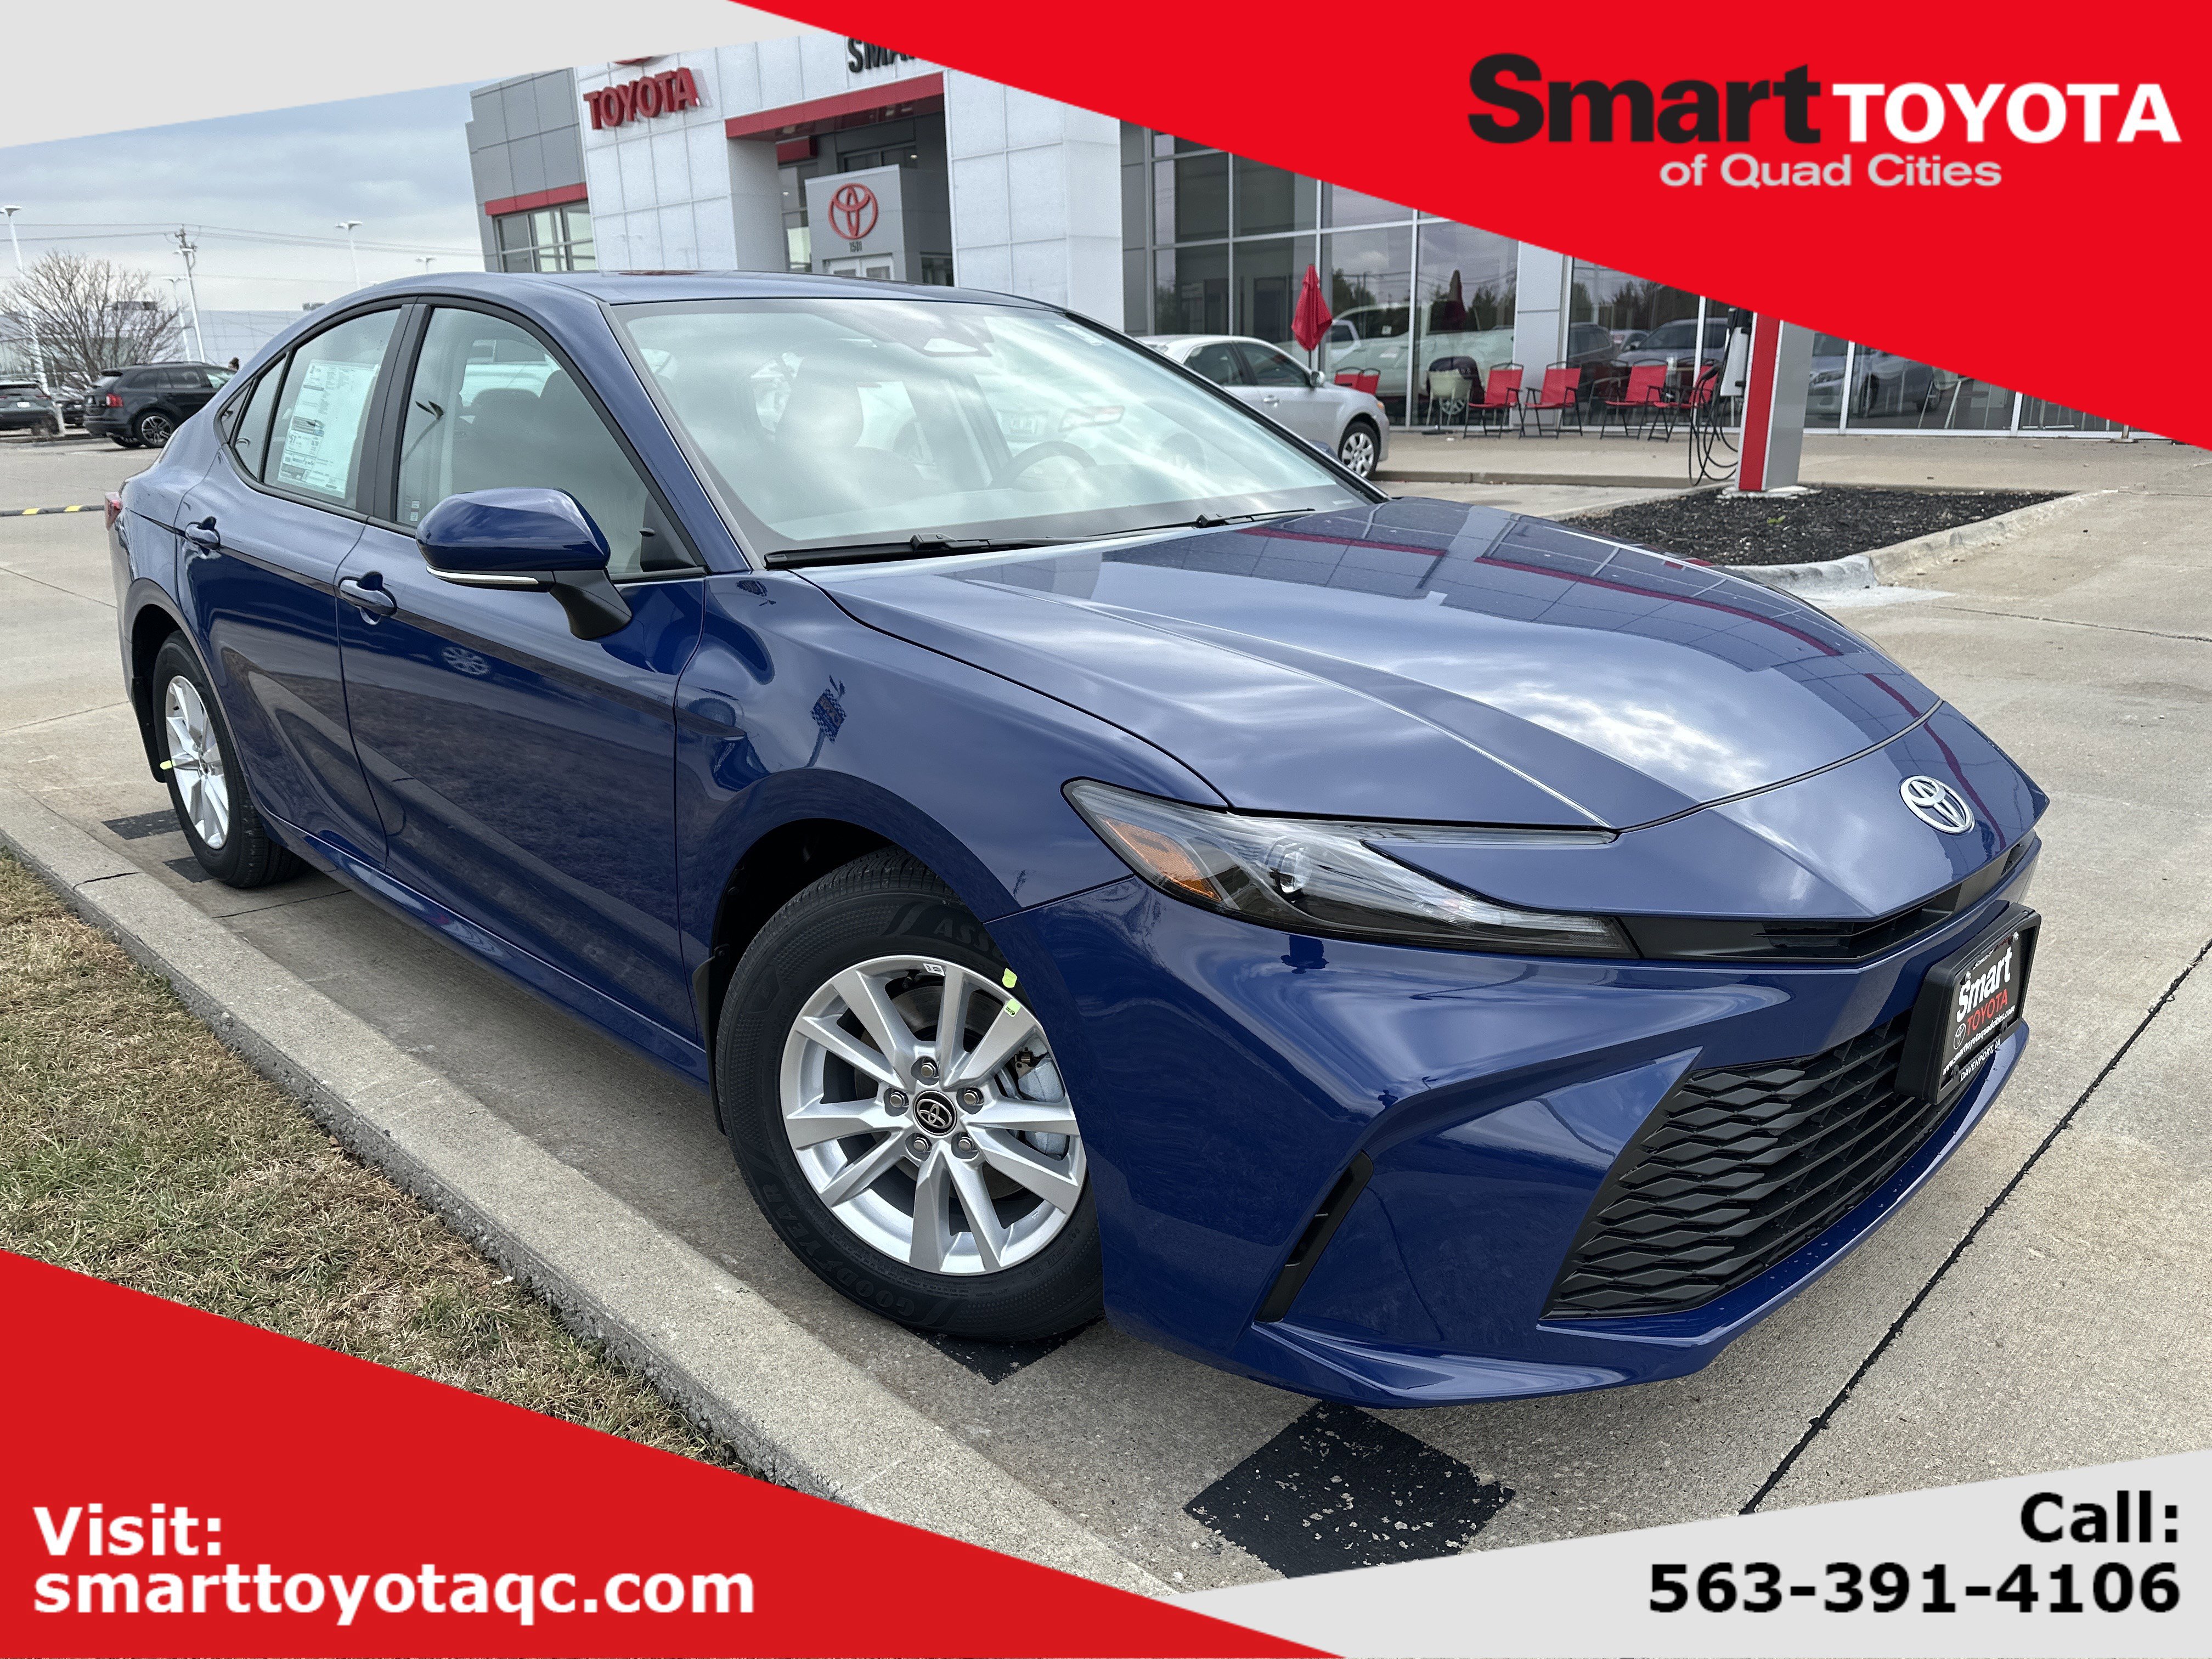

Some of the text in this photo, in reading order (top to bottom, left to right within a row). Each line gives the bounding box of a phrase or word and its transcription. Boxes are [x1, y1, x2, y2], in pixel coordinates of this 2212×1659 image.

[583, 67, 699, 129] TOYOTA
[1956, 946, 2012, 1022] Smart
[1967, 989, 2008, 1036] TOYOTA
[763, 1184, 915, 1317] GOODYEAR
